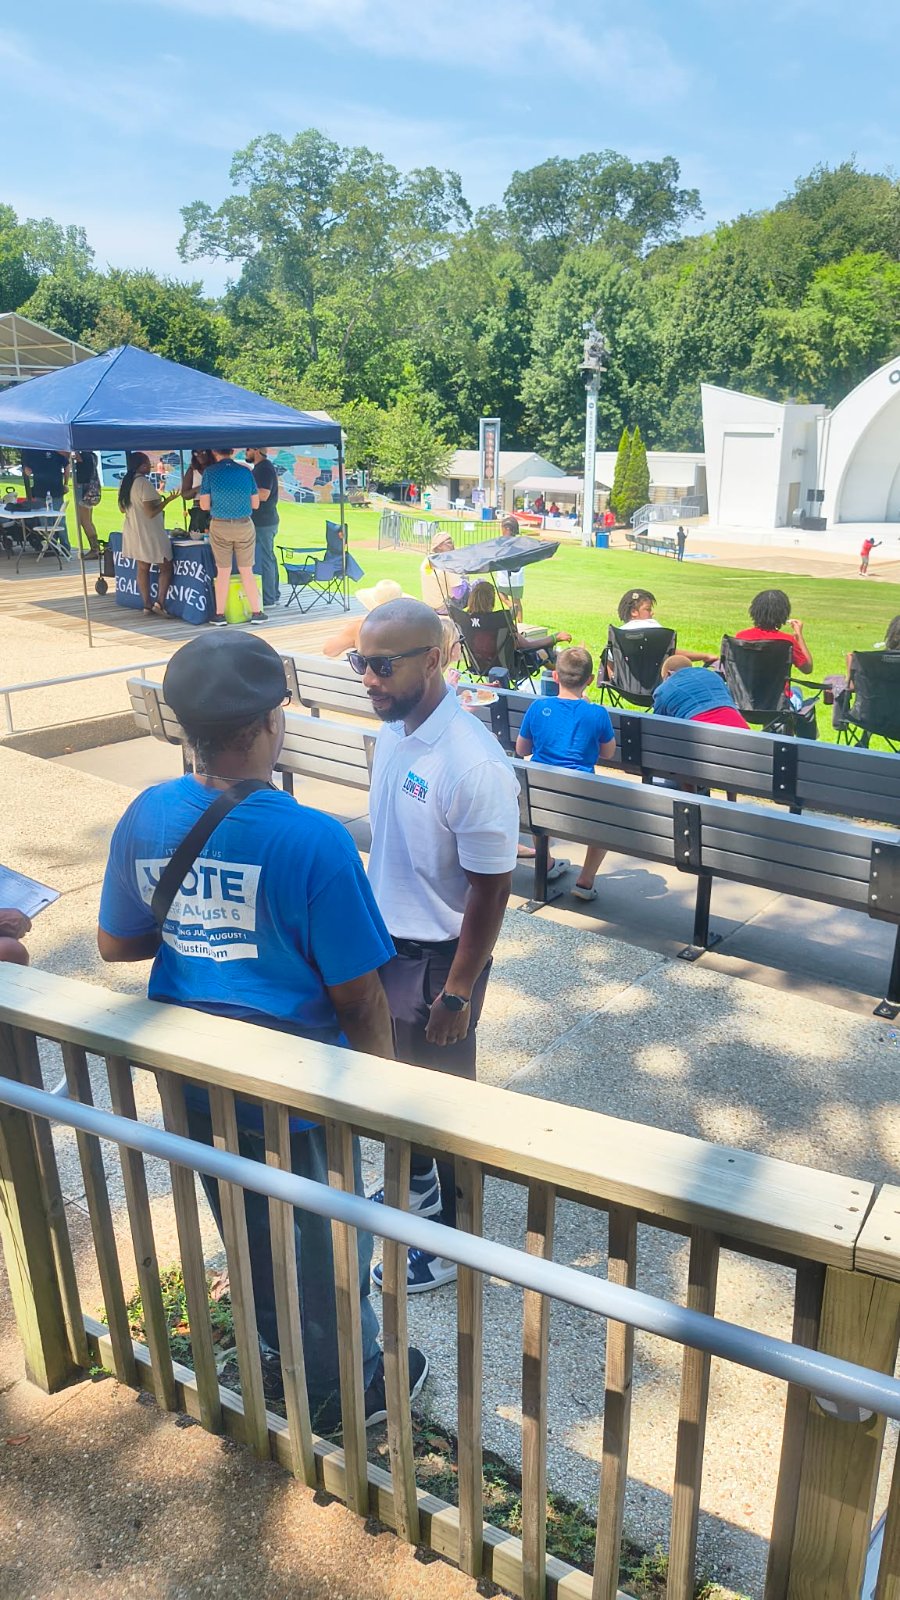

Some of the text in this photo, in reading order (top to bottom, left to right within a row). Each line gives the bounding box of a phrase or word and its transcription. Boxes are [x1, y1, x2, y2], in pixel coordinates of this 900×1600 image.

[150, 583, 206, 611] SRVICES
[403, 777, 428, 799] LOWERY
[182, 903, 227, 921] Auust
[231, 908, 241, 921] 6
[193, 929, 207, 937] JUL
[209, 932, 241, 941] AUGUST
